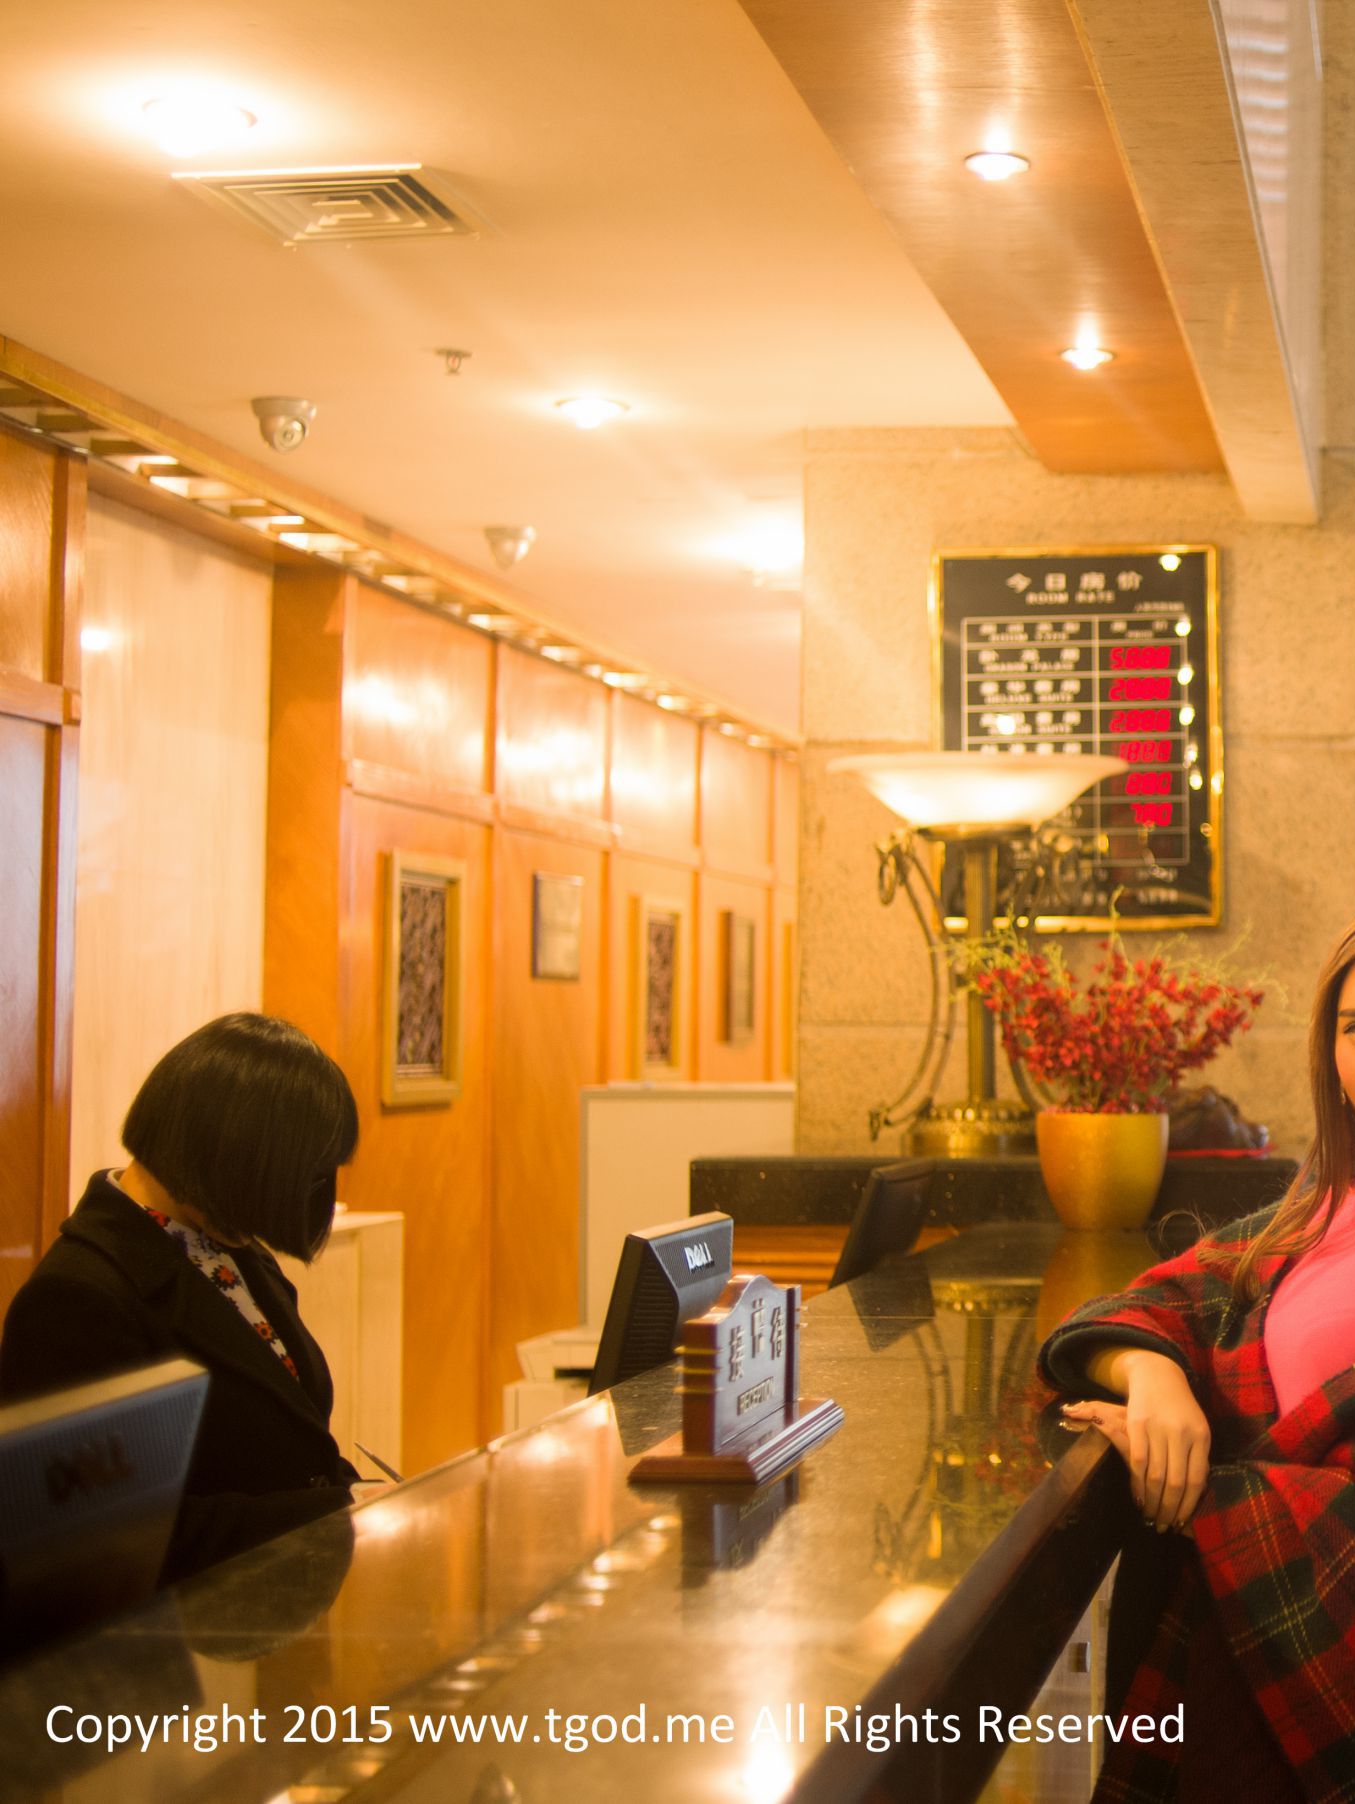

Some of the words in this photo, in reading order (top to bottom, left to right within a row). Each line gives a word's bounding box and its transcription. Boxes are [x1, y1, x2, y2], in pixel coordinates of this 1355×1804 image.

[1025, 592, 1069, 605] ROOM
[1075, 591, 1115, 604] RATE
[1125, 772, 1172, 795] 880
